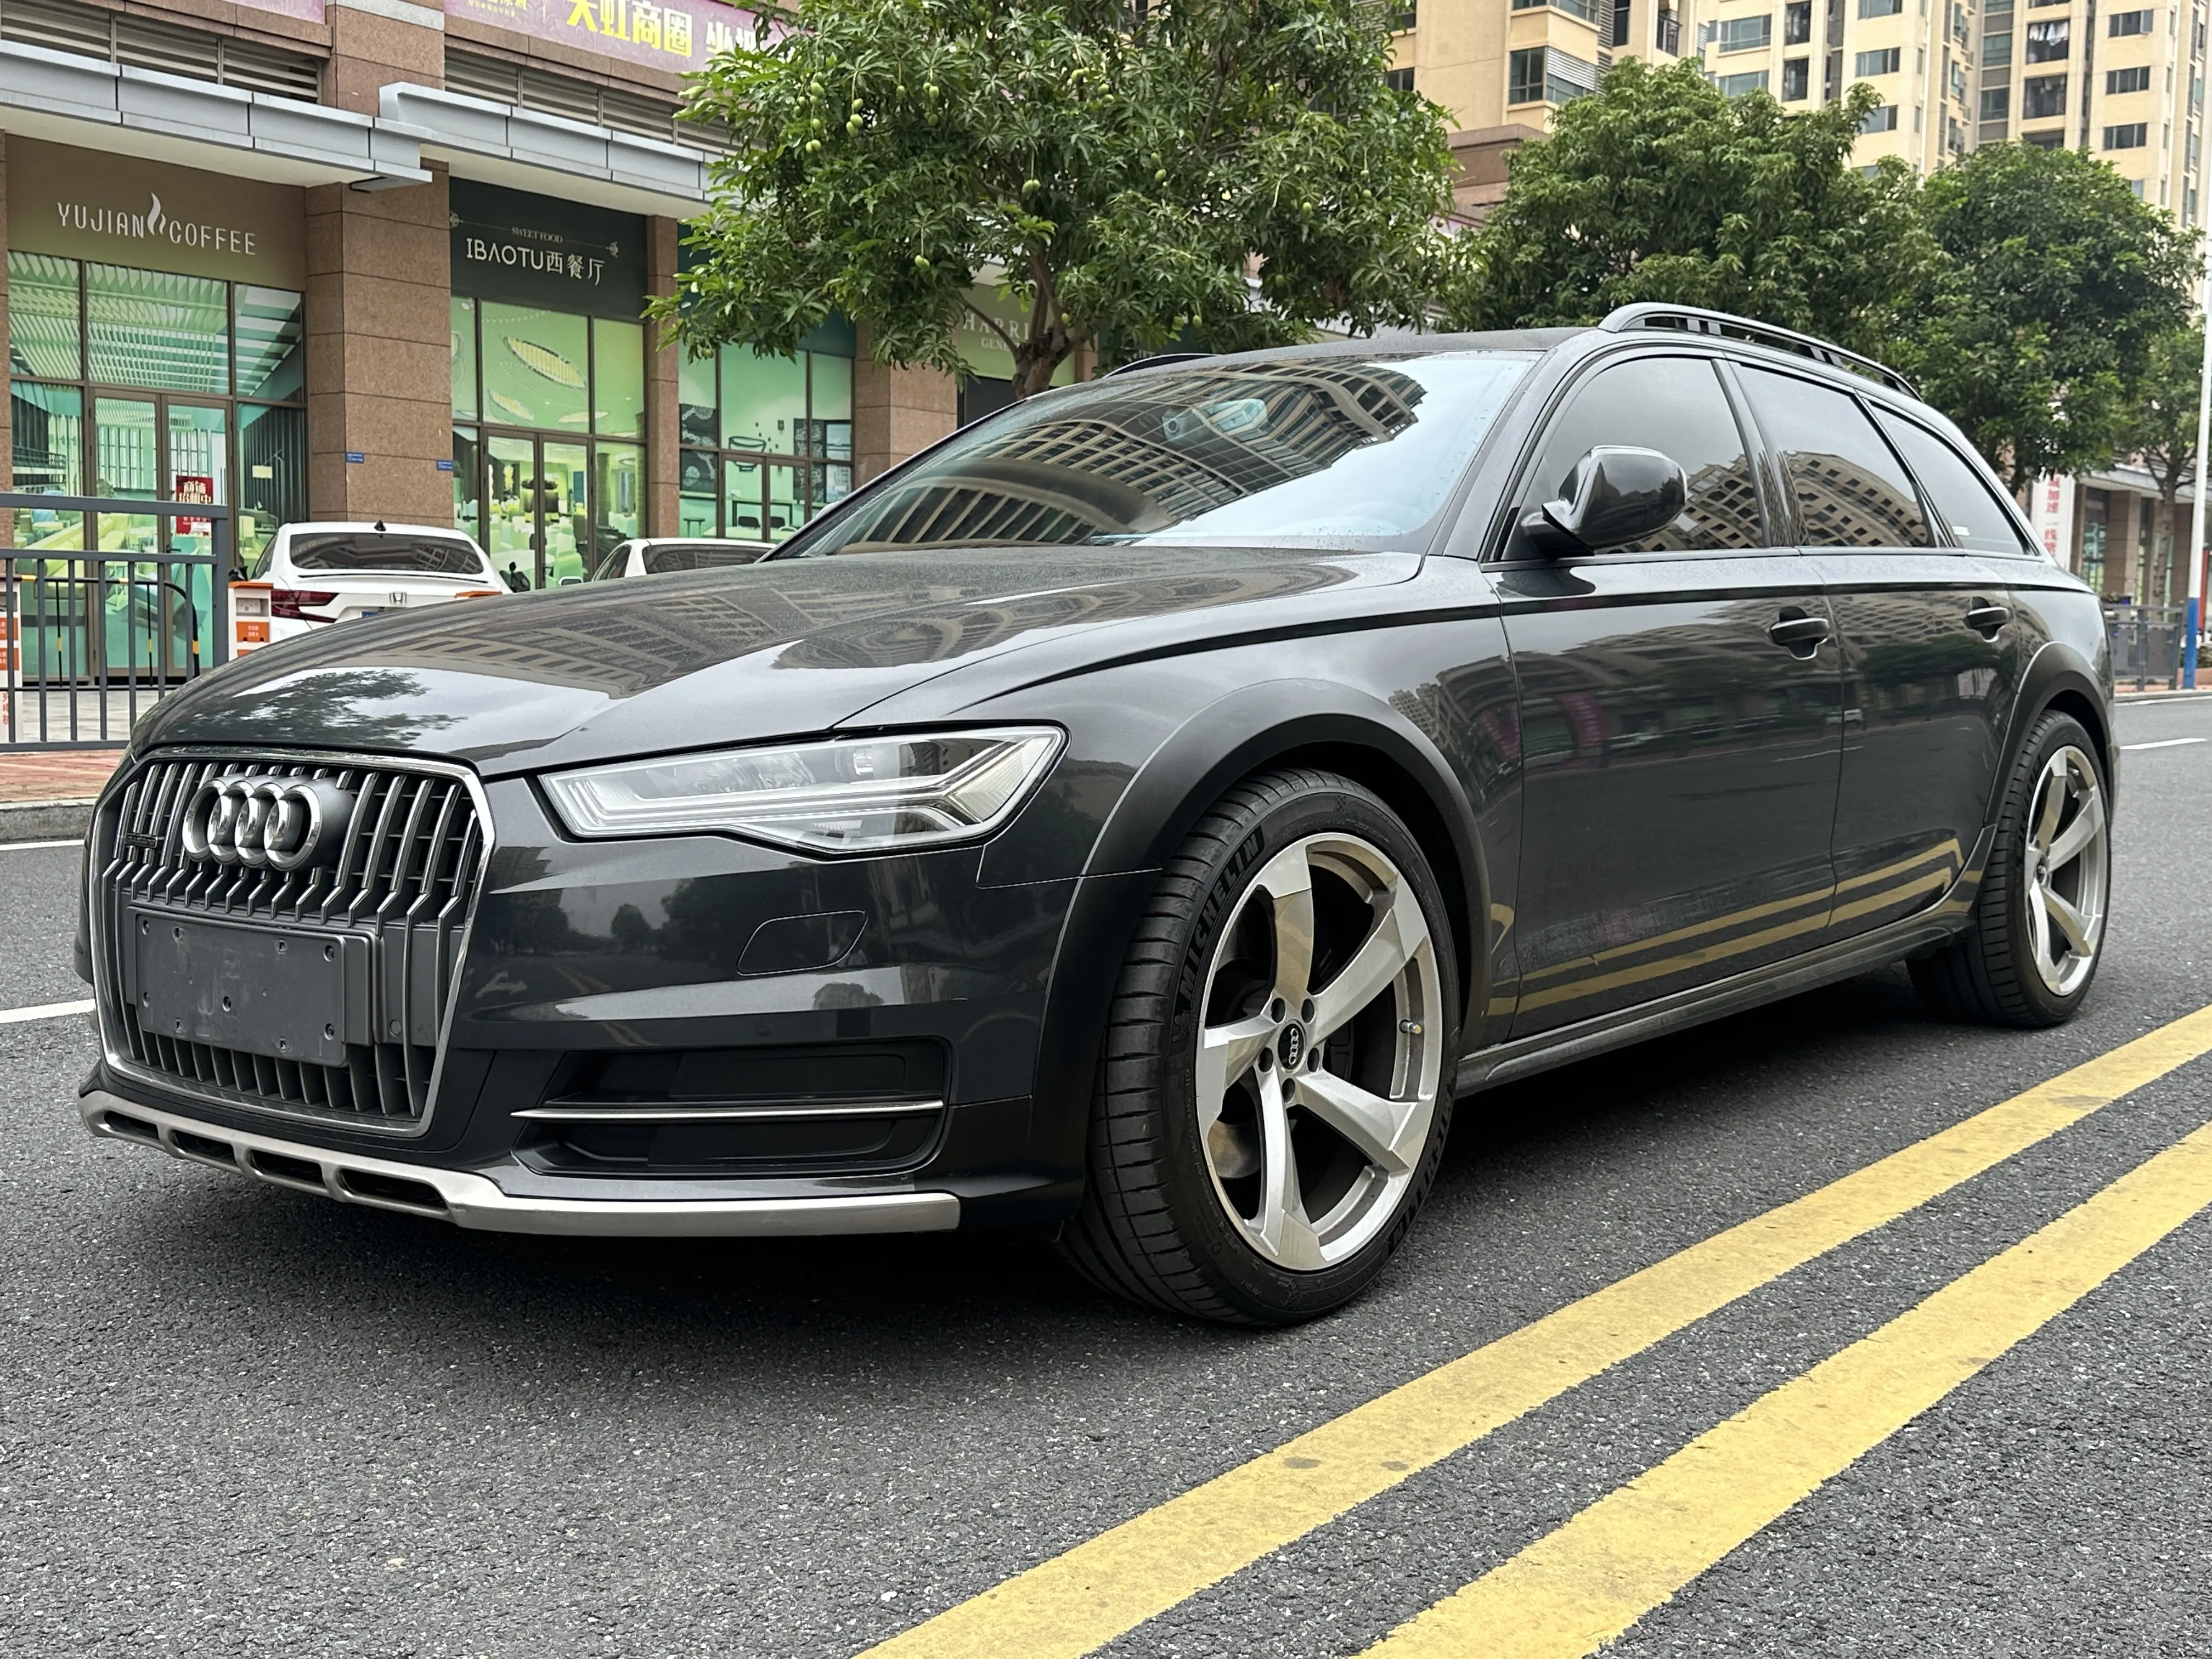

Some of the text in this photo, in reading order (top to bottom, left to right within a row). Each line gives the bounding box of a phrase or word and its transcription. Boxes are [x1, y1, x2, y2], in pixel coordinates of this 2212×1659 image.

[58, 201, 256, 256] YUJIAN COFFEE
[511, 227, 563, 244] SWEET FOOD
[1180, 832, 1260, 1002] MICHELIN
